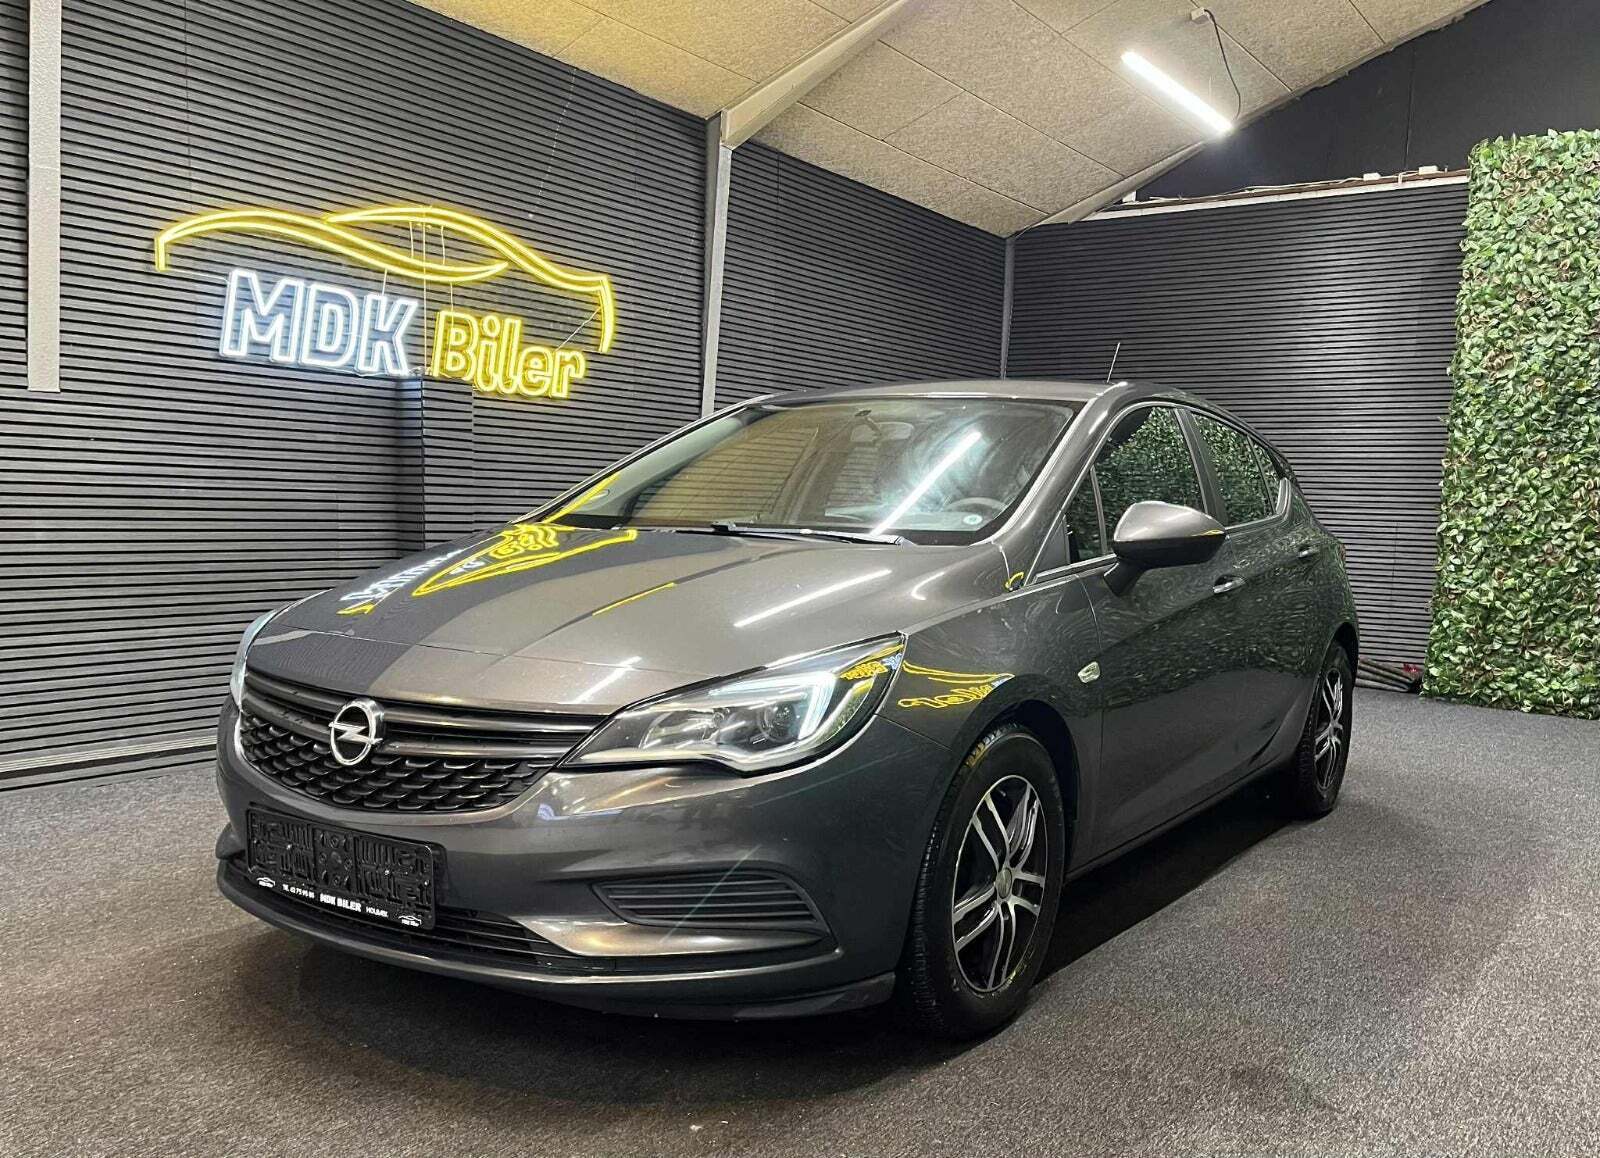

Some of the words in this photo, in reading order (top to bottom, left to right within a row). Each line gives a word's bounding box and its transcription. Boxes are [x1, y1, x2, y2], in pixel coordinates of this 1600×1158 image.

[219, 269, 418, 376] MDK
[431, 310, 586, 398] Biler
[337, 897, 362, 912] BILER
